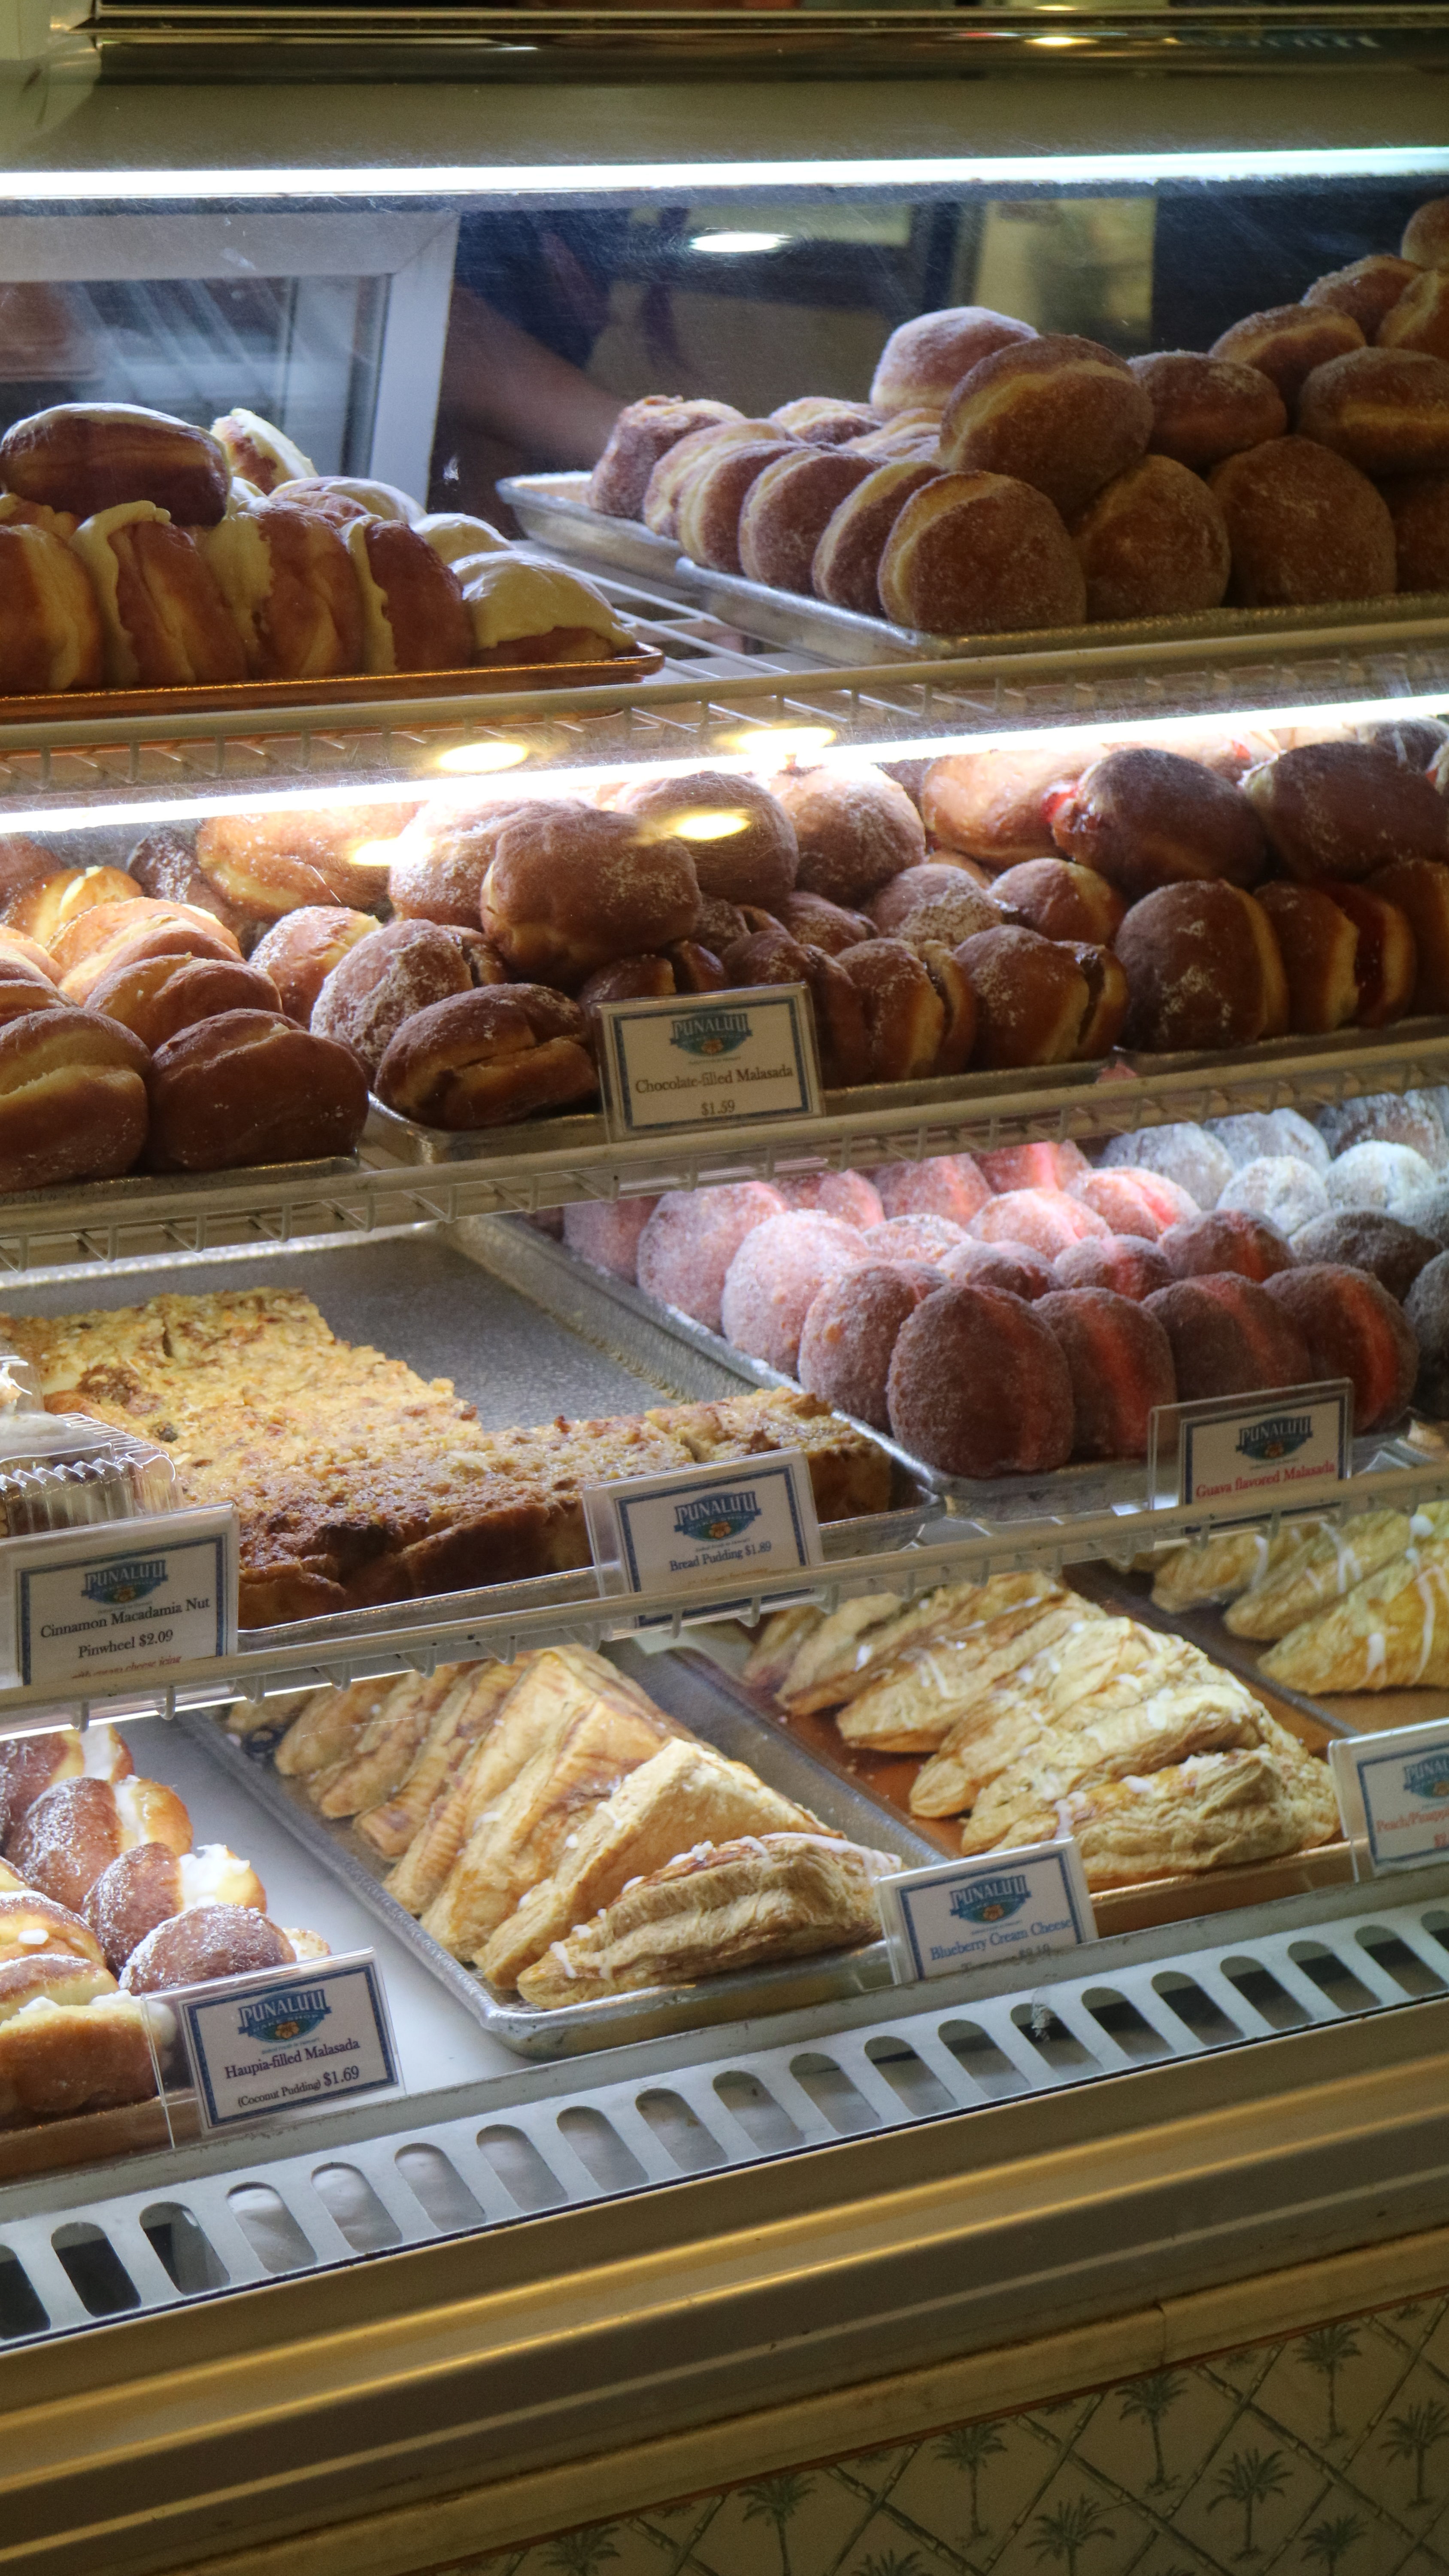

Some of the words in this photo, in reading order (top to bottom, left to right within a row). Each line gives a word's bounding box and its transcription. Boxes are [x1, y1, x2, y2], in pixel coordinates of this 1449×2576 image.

[635, 1072, 733, 1094] Chocolate-filled
[737, 1064, 794, 1084] Malasada
[701, 1100, 735, 1116] $1.59
[1196, 1482, 1232, 1498] Guava
[1235, 1470, 1280, 1491] flavored
[1283, 1460, 1335, 1482] Malasada
[670, 1555, 700, 1571] Bread
[701, 1549, 743, 1564] Pudding
[40, 1618, 107, 1638] Cinnamon
[110, 1602, 183, 1626] Macadamia
[186, 1597, 211, 1611] Nut
[77, 1636, 136, 1659] Pinwheel
[139, 1629, 173, 1647] $2.09
[930, 1936, 988, 1961] Blueberry
[989, 1929, 1029, 1946] Cream
[1031, 1918, 1073, 1936] Cheese
[225, 2050, 303, 2079] Haupia-filled
[305, 2037, 361, 2061] Malasada
[238, 2091, 279, 2108] (Coconut
[281, 2079, 322, 2097] Pudding)
[323, 2066, 360, 2087] $1.69
